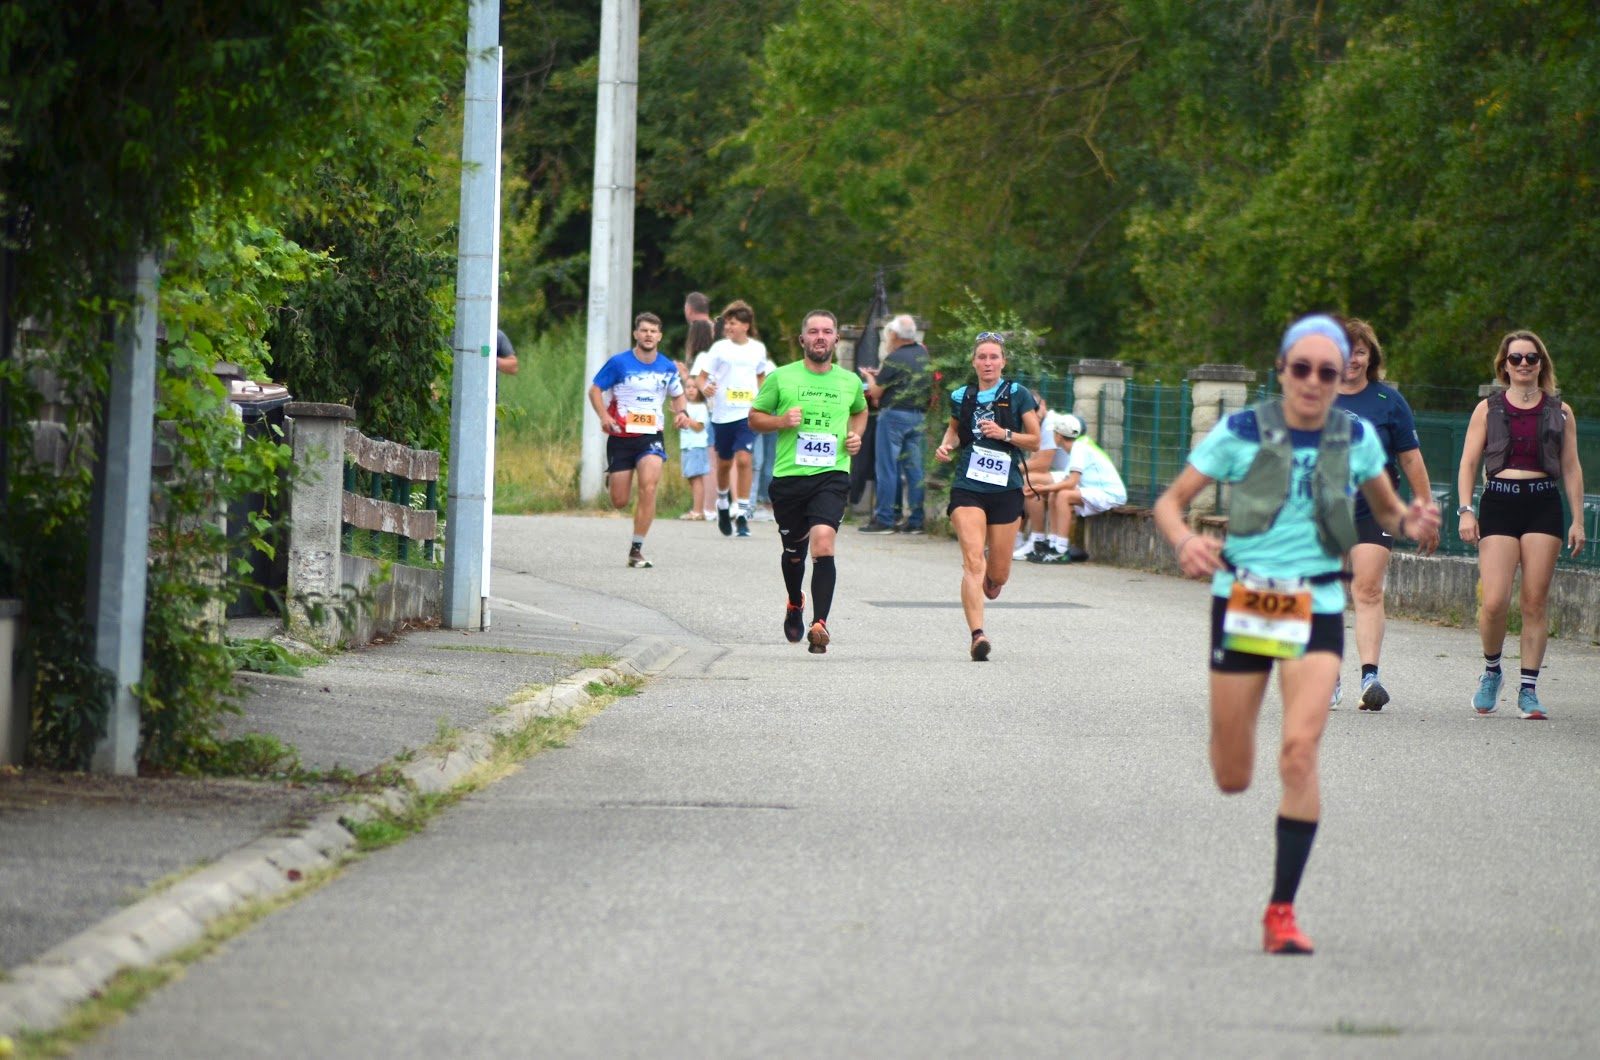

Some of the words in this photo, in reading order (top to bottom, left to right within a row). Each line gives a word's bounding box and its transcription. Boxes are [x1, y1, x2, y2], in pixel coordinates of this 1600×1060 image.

[825, 391, 838, 399] RUN
[633, 414, 652, 424] 263
[804, 441, 830, 453] 445
[977, 457, 1004, 471] 495
[1245, 592, 1297, 616] 202
